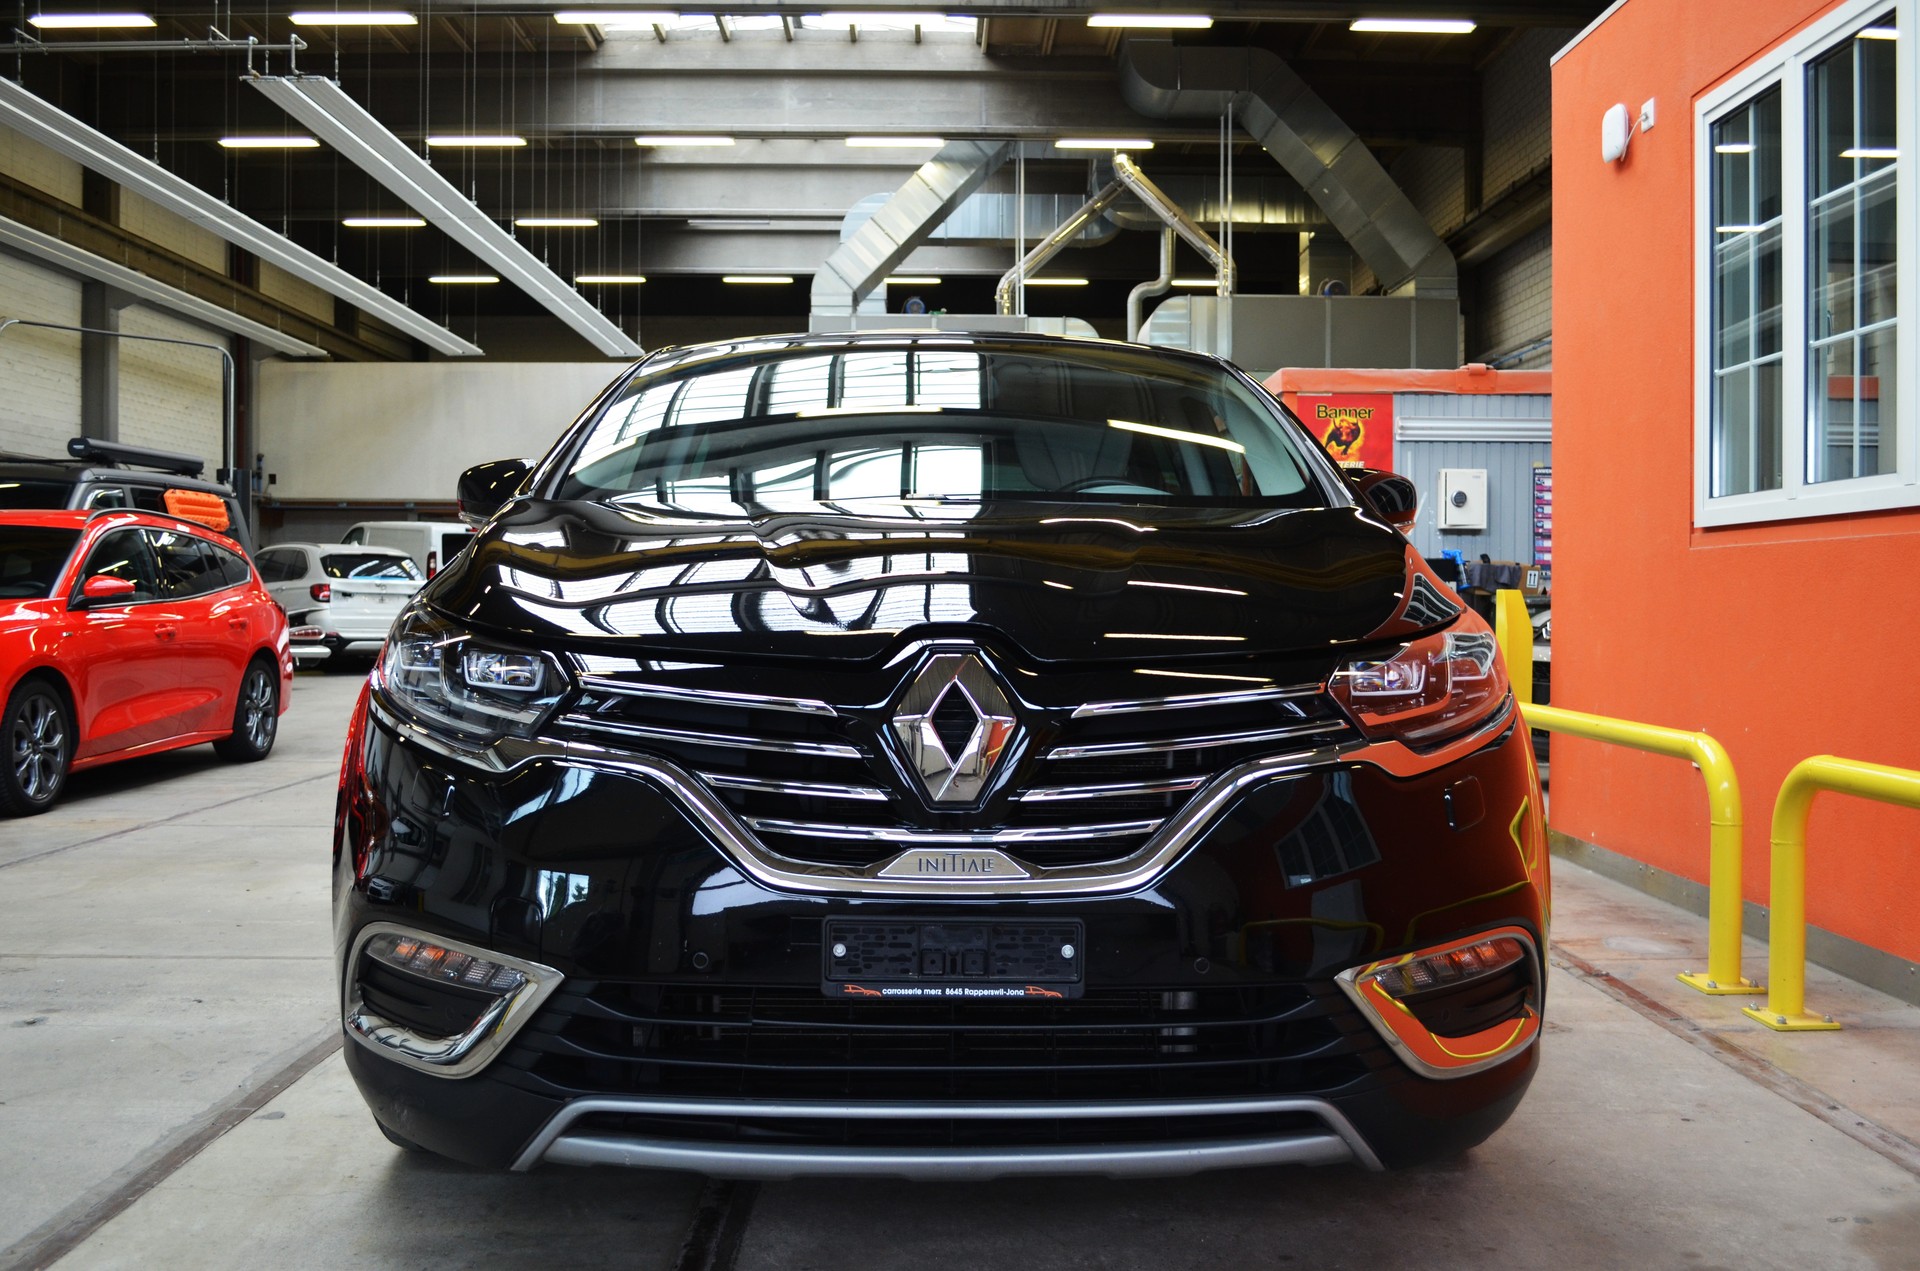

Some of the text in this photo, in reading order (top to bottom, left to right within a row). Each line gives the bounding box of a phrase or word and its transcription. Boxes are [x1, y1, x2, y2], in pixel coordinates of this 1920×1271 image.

[1316, 404, 1374, 419] Banner
[1336, 461, 1365, 469] TERIE
[918, 853, 994, 873] INITIALE
[882, 987, 922, 995] carrosserie
[945, 988, 963, 996] 8645
[964, 988, 1025, 997] Rapperswil-Jona
